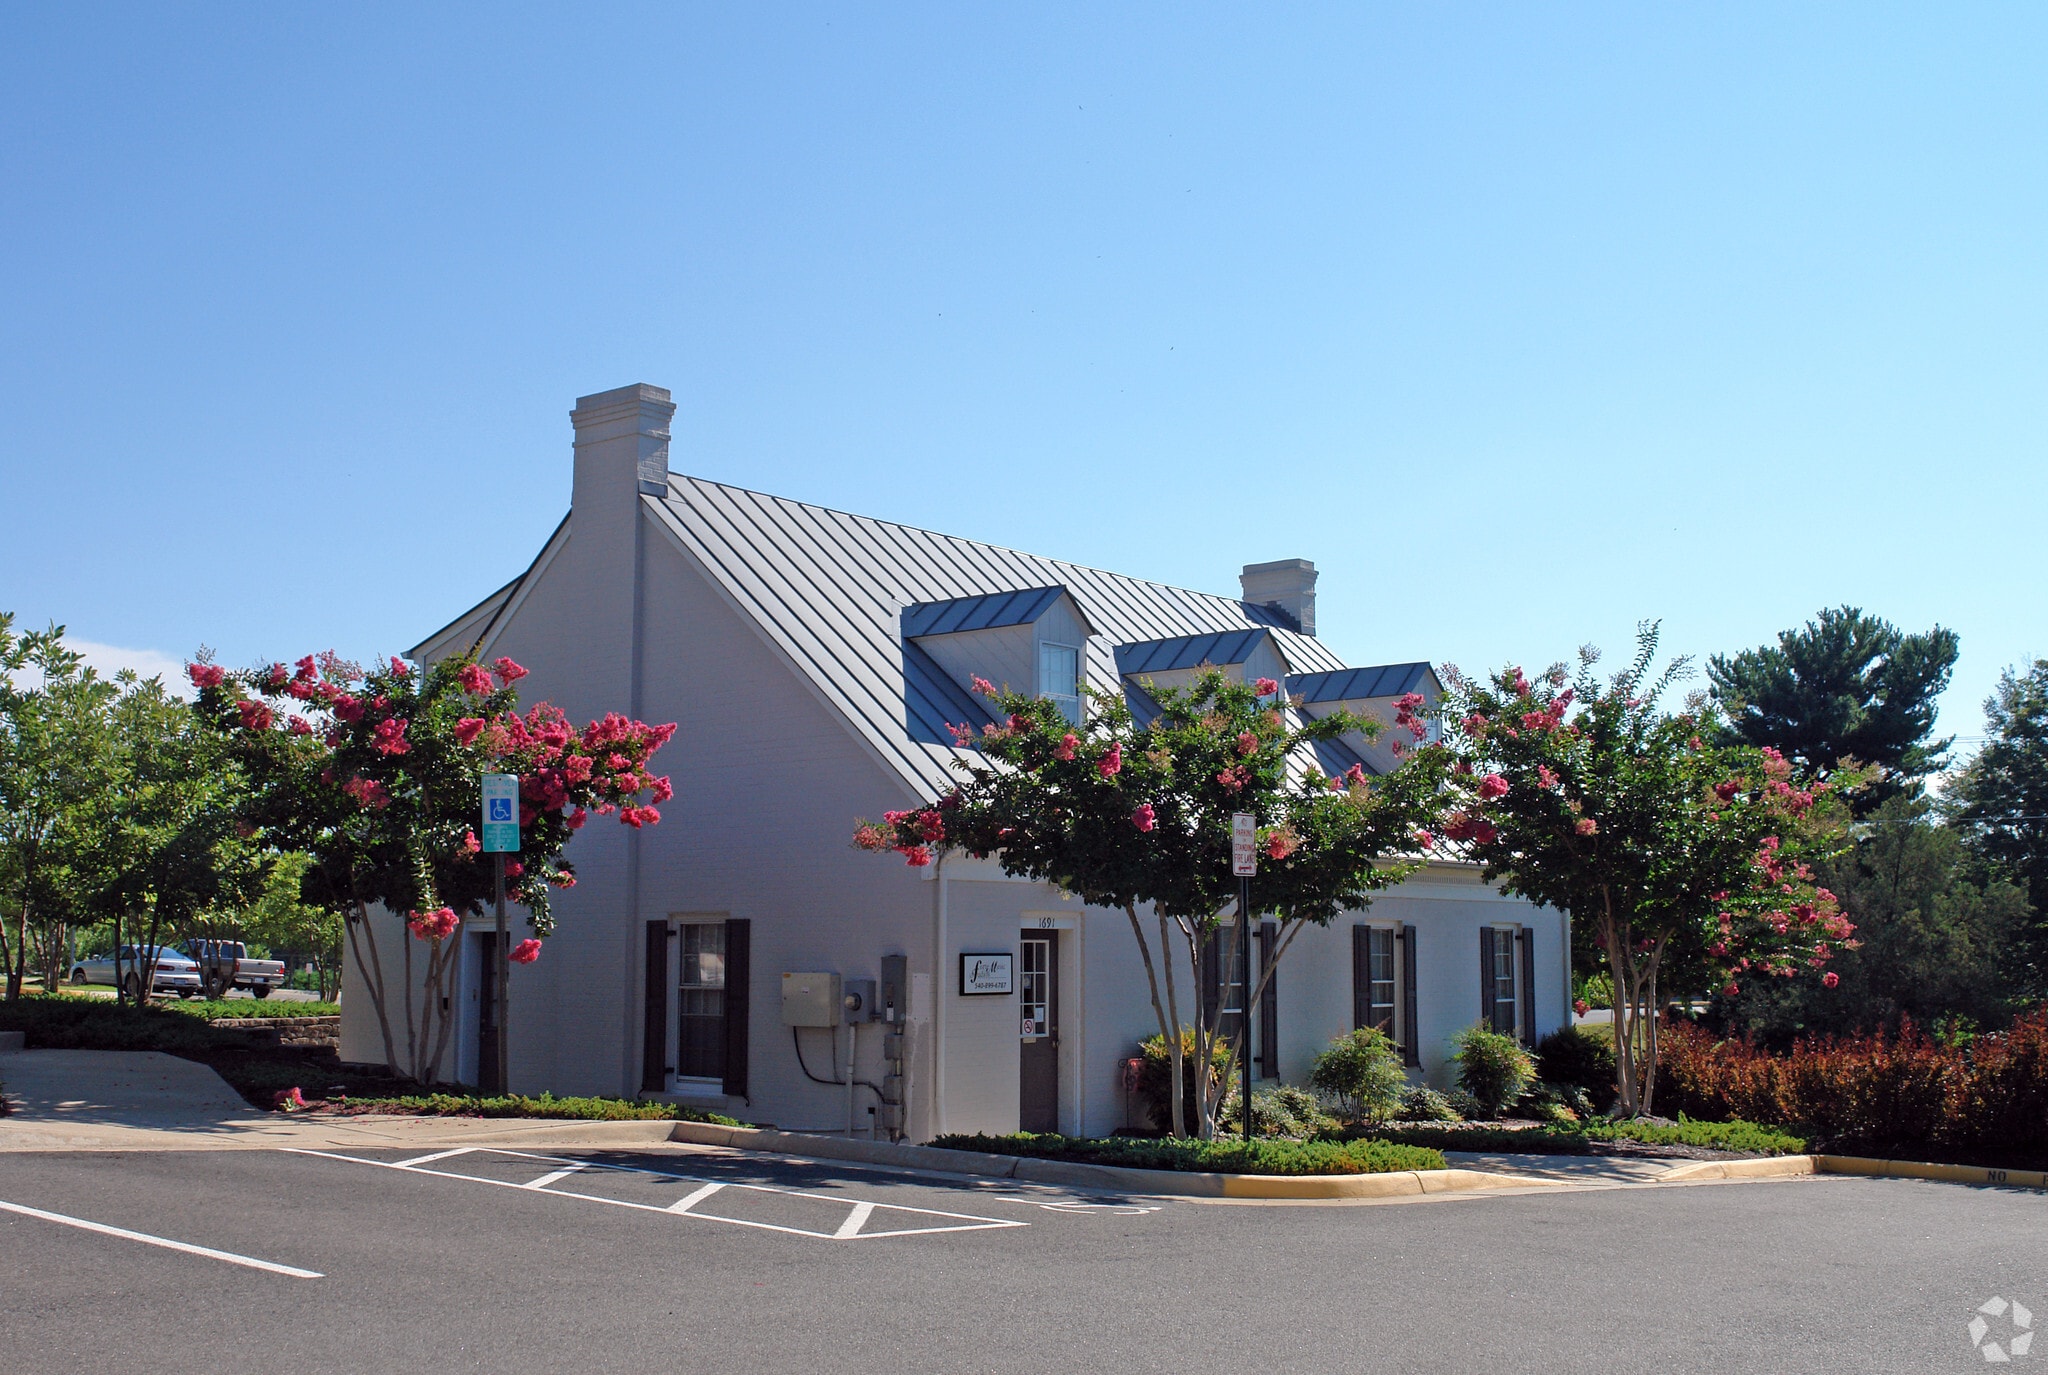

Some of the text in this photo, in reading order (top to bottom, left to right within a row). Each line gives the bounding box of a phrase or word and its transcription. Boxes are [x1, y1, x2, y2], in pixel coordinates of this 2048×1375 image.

[1236, 829, 1253, 837] PARKING
[1234, 844, 1254, 852] STANDING
[1234, 854, 1254, 864] FIRE LANE
[1039, 917, 1055, 928] 1691
[1988, 1171, 2006, 1182] NO
